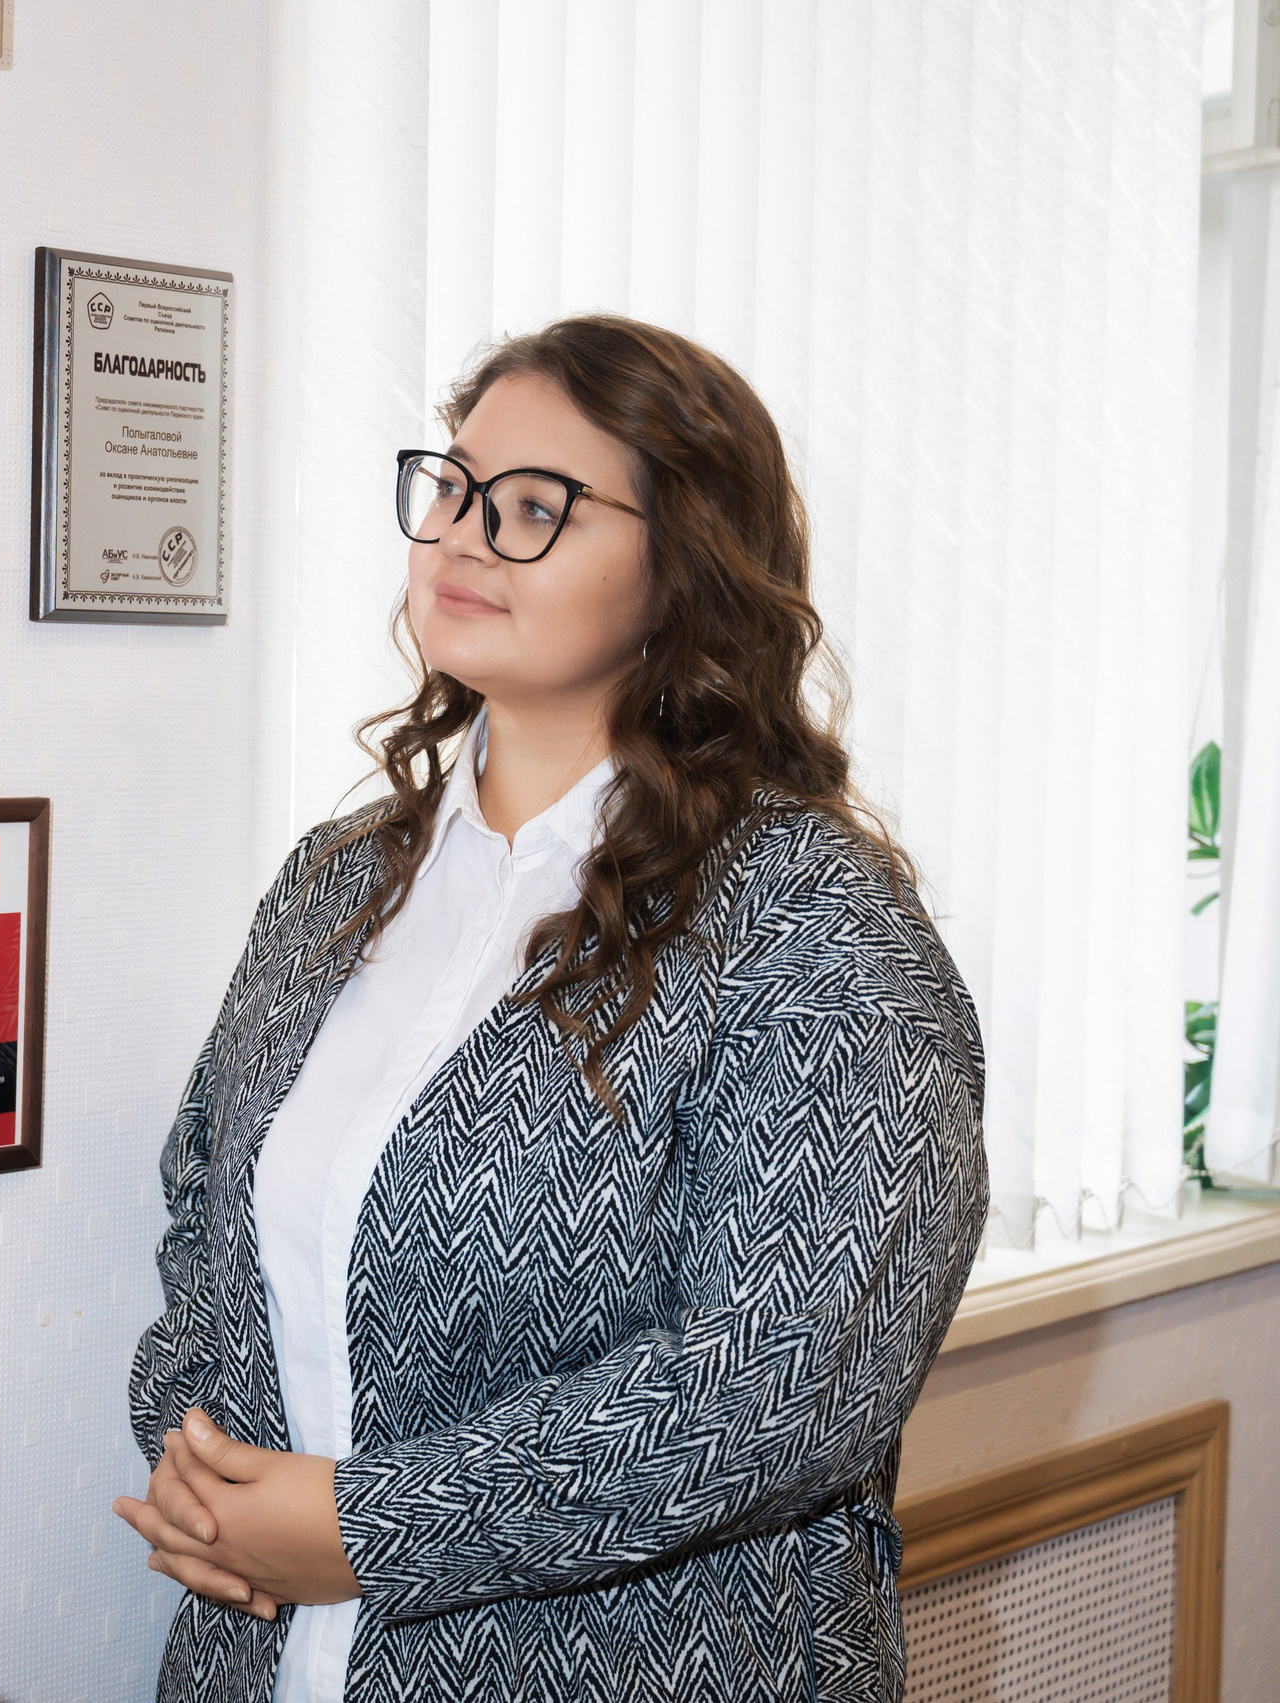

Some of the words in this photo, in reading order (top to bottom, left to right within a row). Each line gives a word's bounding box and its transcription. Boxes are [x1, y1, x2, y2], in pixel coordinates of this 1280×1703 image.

[138, 300, 156, 308] Первый
[157, 303, 191, 313] Всероссийский
[157, 311, 172, 319] Съезд
[93, 352, 206, 382] БЛАГОДАРНОСТЬ
[121, 425, 182, 441] Полыгаловой
[104, 440, 137, 454] Оксане
[140, 444, 197, 459] Анатольевне
